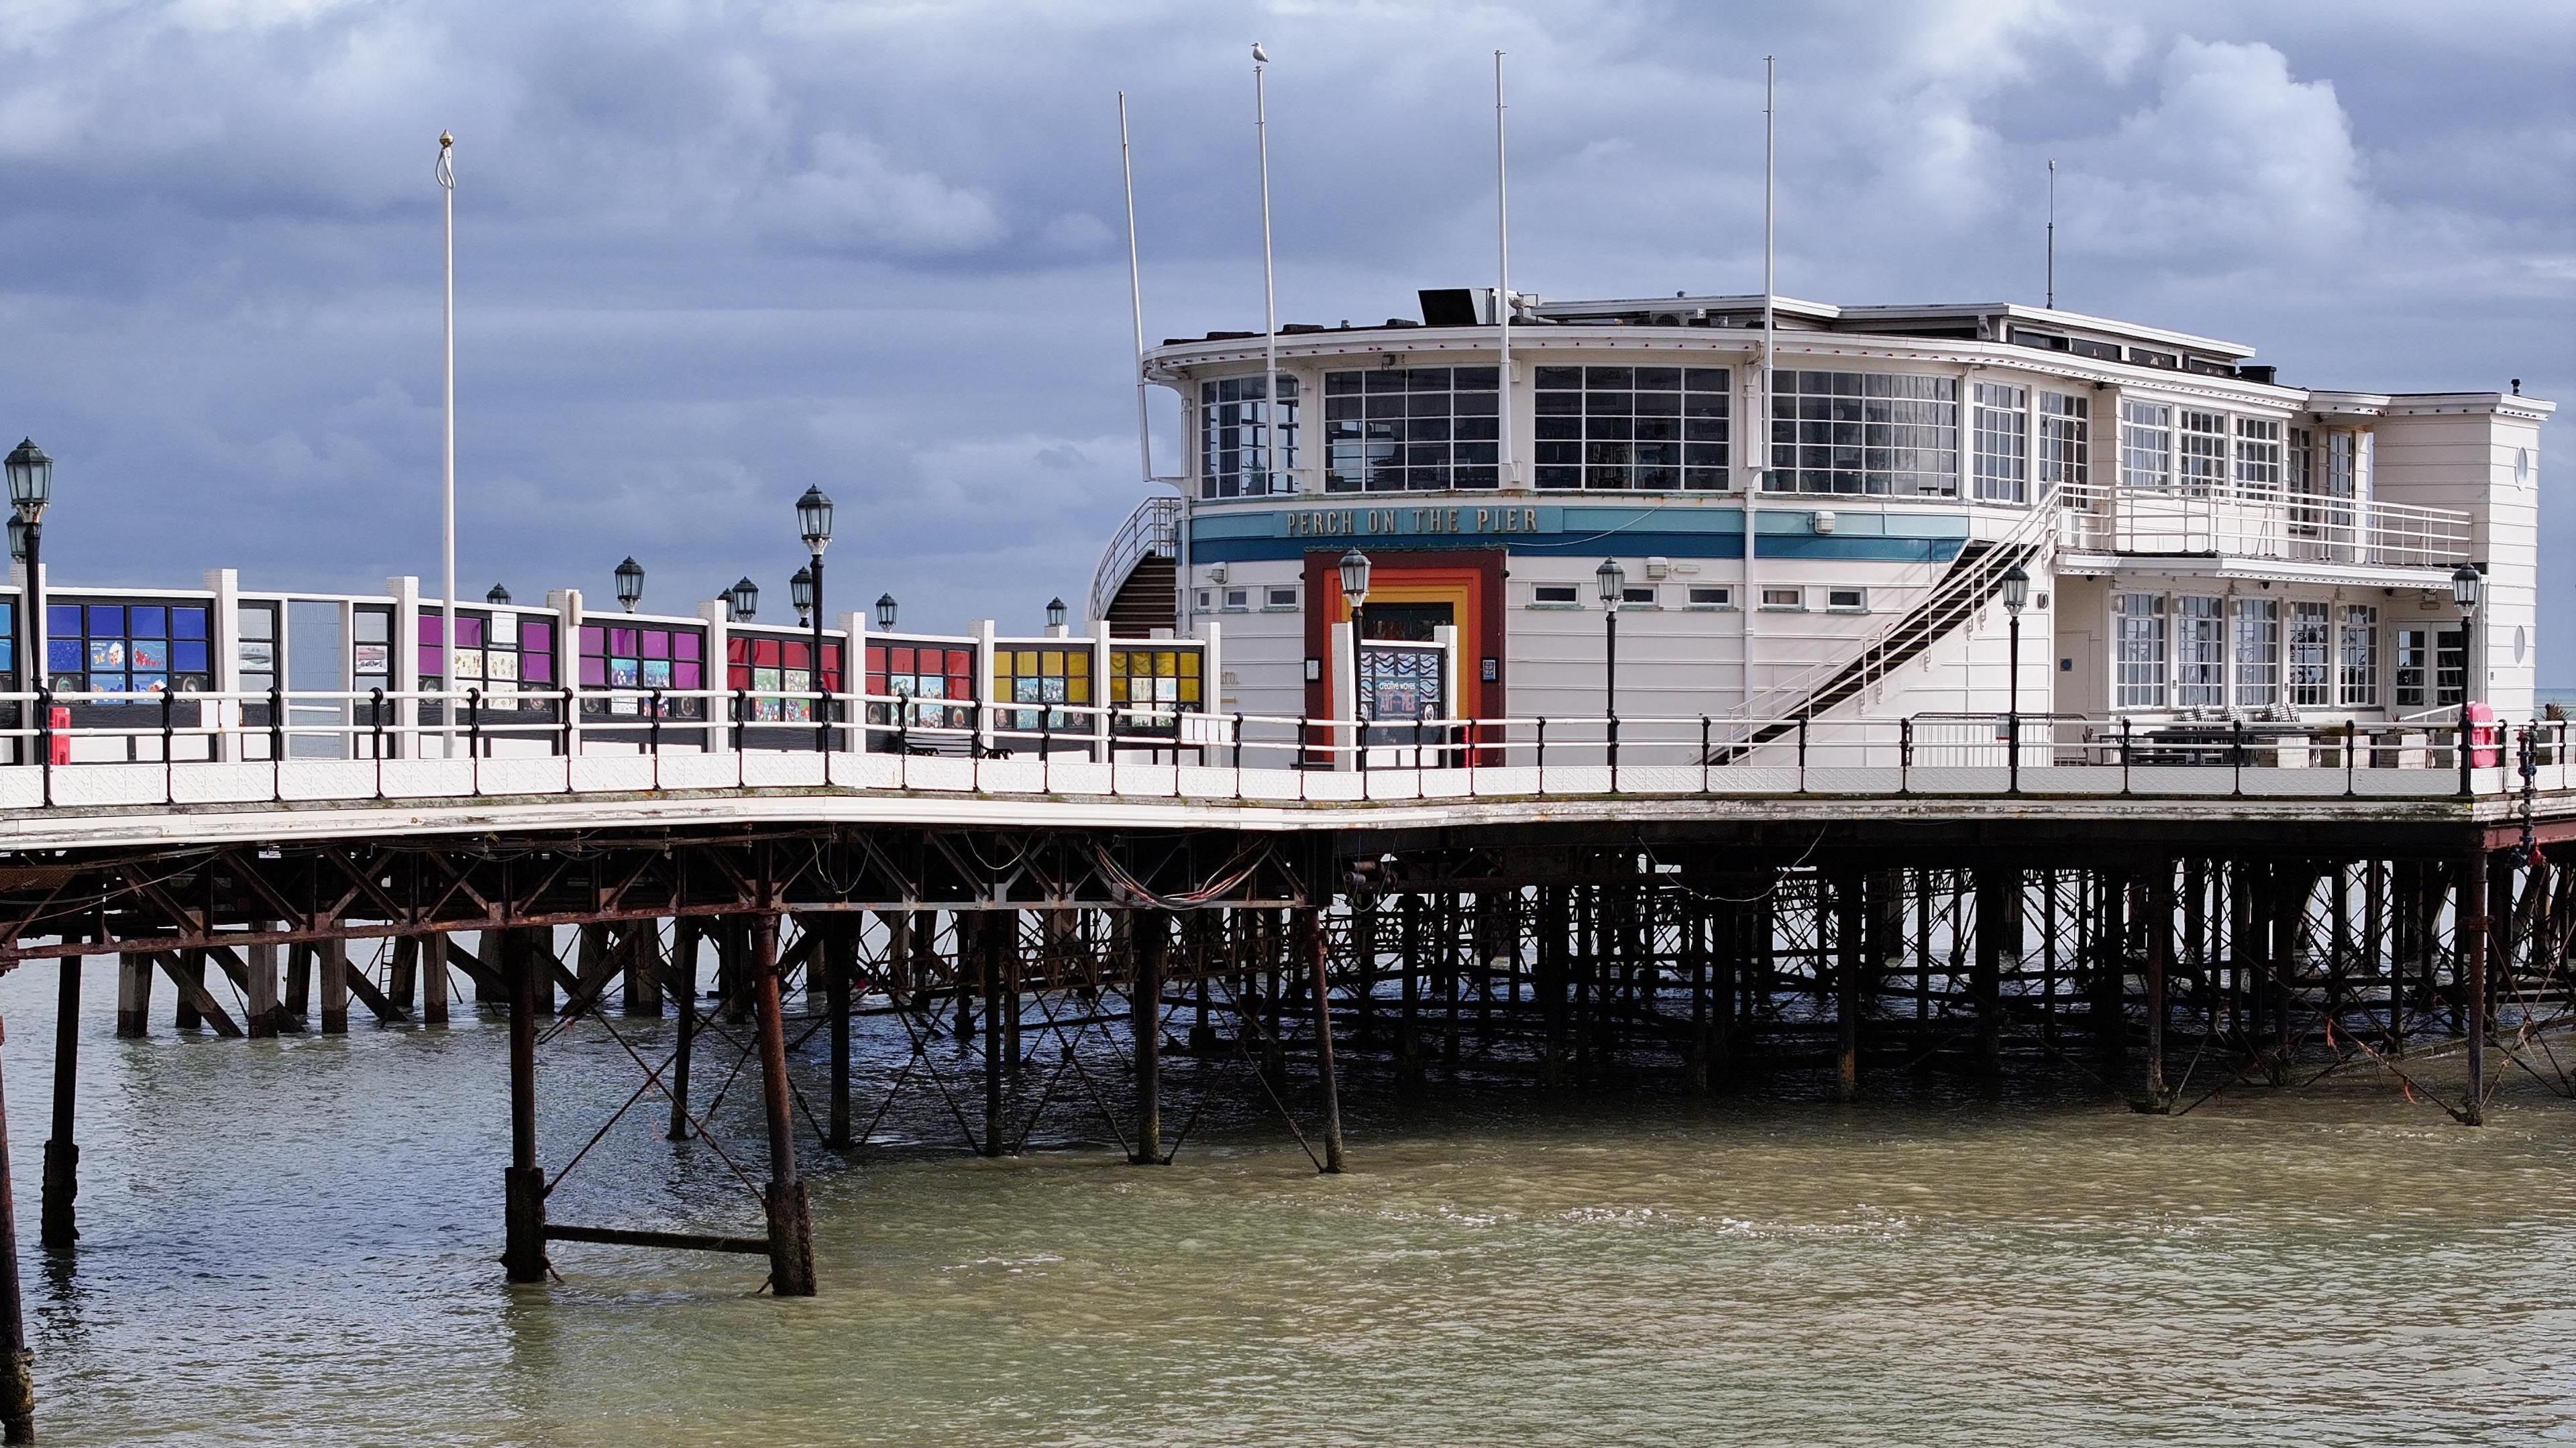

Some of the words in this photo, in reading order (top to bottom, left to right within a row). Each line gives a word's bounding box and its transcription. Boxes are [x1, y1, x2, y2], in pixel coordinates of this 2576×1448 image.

[1287, 510, 1354, 535] PERCH
[1368, 510, 1396, 533] ON
[1413, 509, 1460, 532] THE
[1477, 508, 1537, 531] PIER
[1379, 681, 1399, 690] creative
